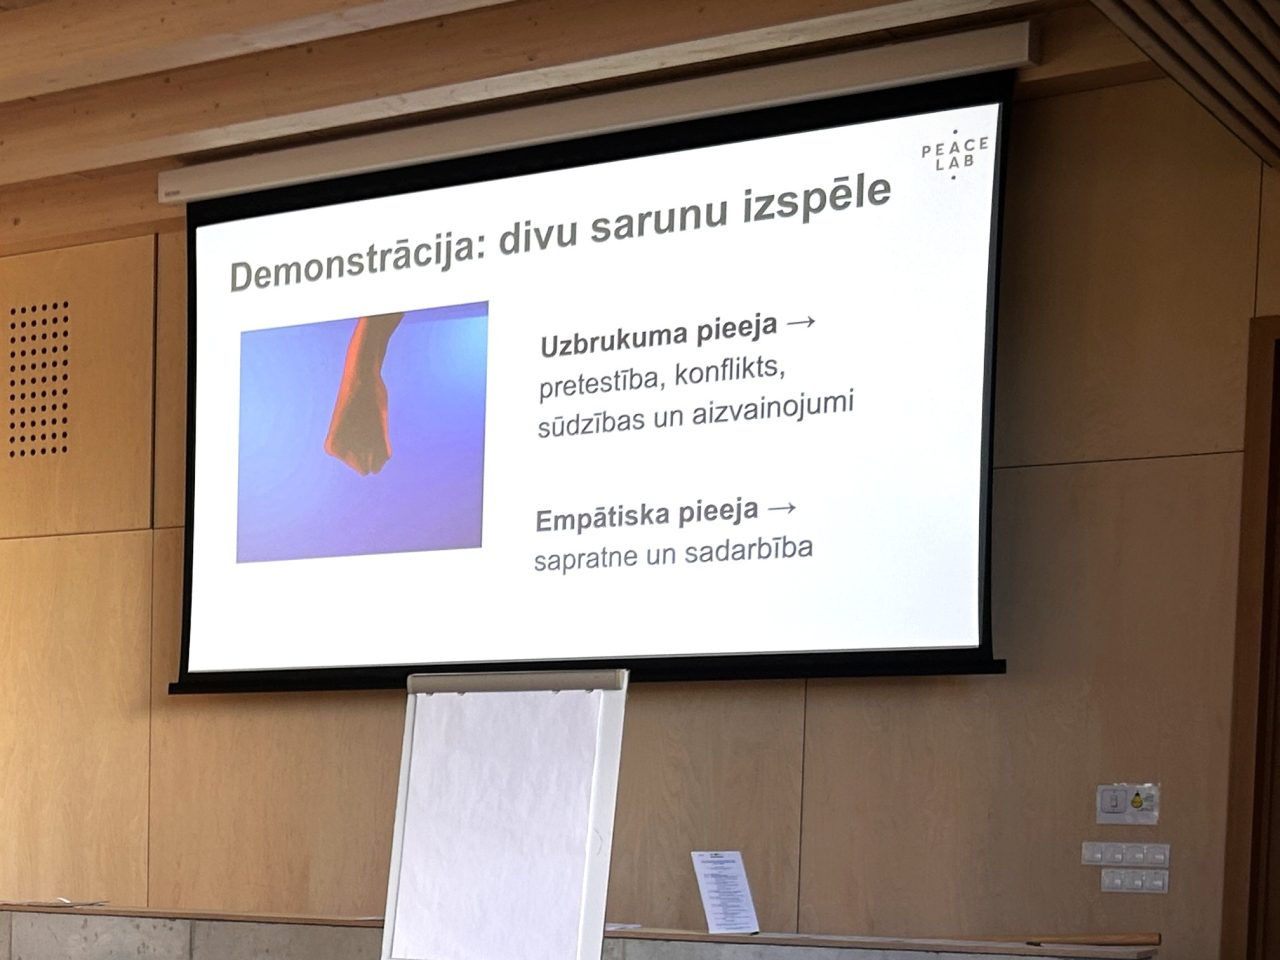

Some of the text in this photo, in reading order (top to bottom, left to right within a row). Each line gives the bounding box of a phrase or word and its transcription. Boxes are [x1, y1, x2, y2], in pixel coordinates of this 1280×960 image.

[921, 136, 988, 158] PEACE
[935, 154, 974, 171] LAB
[230, 172, 891, 293] Demonstrācija: divu sarunu izspēle
[541, 312, 777, 358] Uzbrukuma pieeja
[539, 355, 785, 405] pretestība, konflikts,
[538, 387, 854, 439] sūdzības un aizvainojumi
[536, 496, 758, 535] Empātiska pieeja
[534, 535, 813, 576] sapratne un sadarbība
